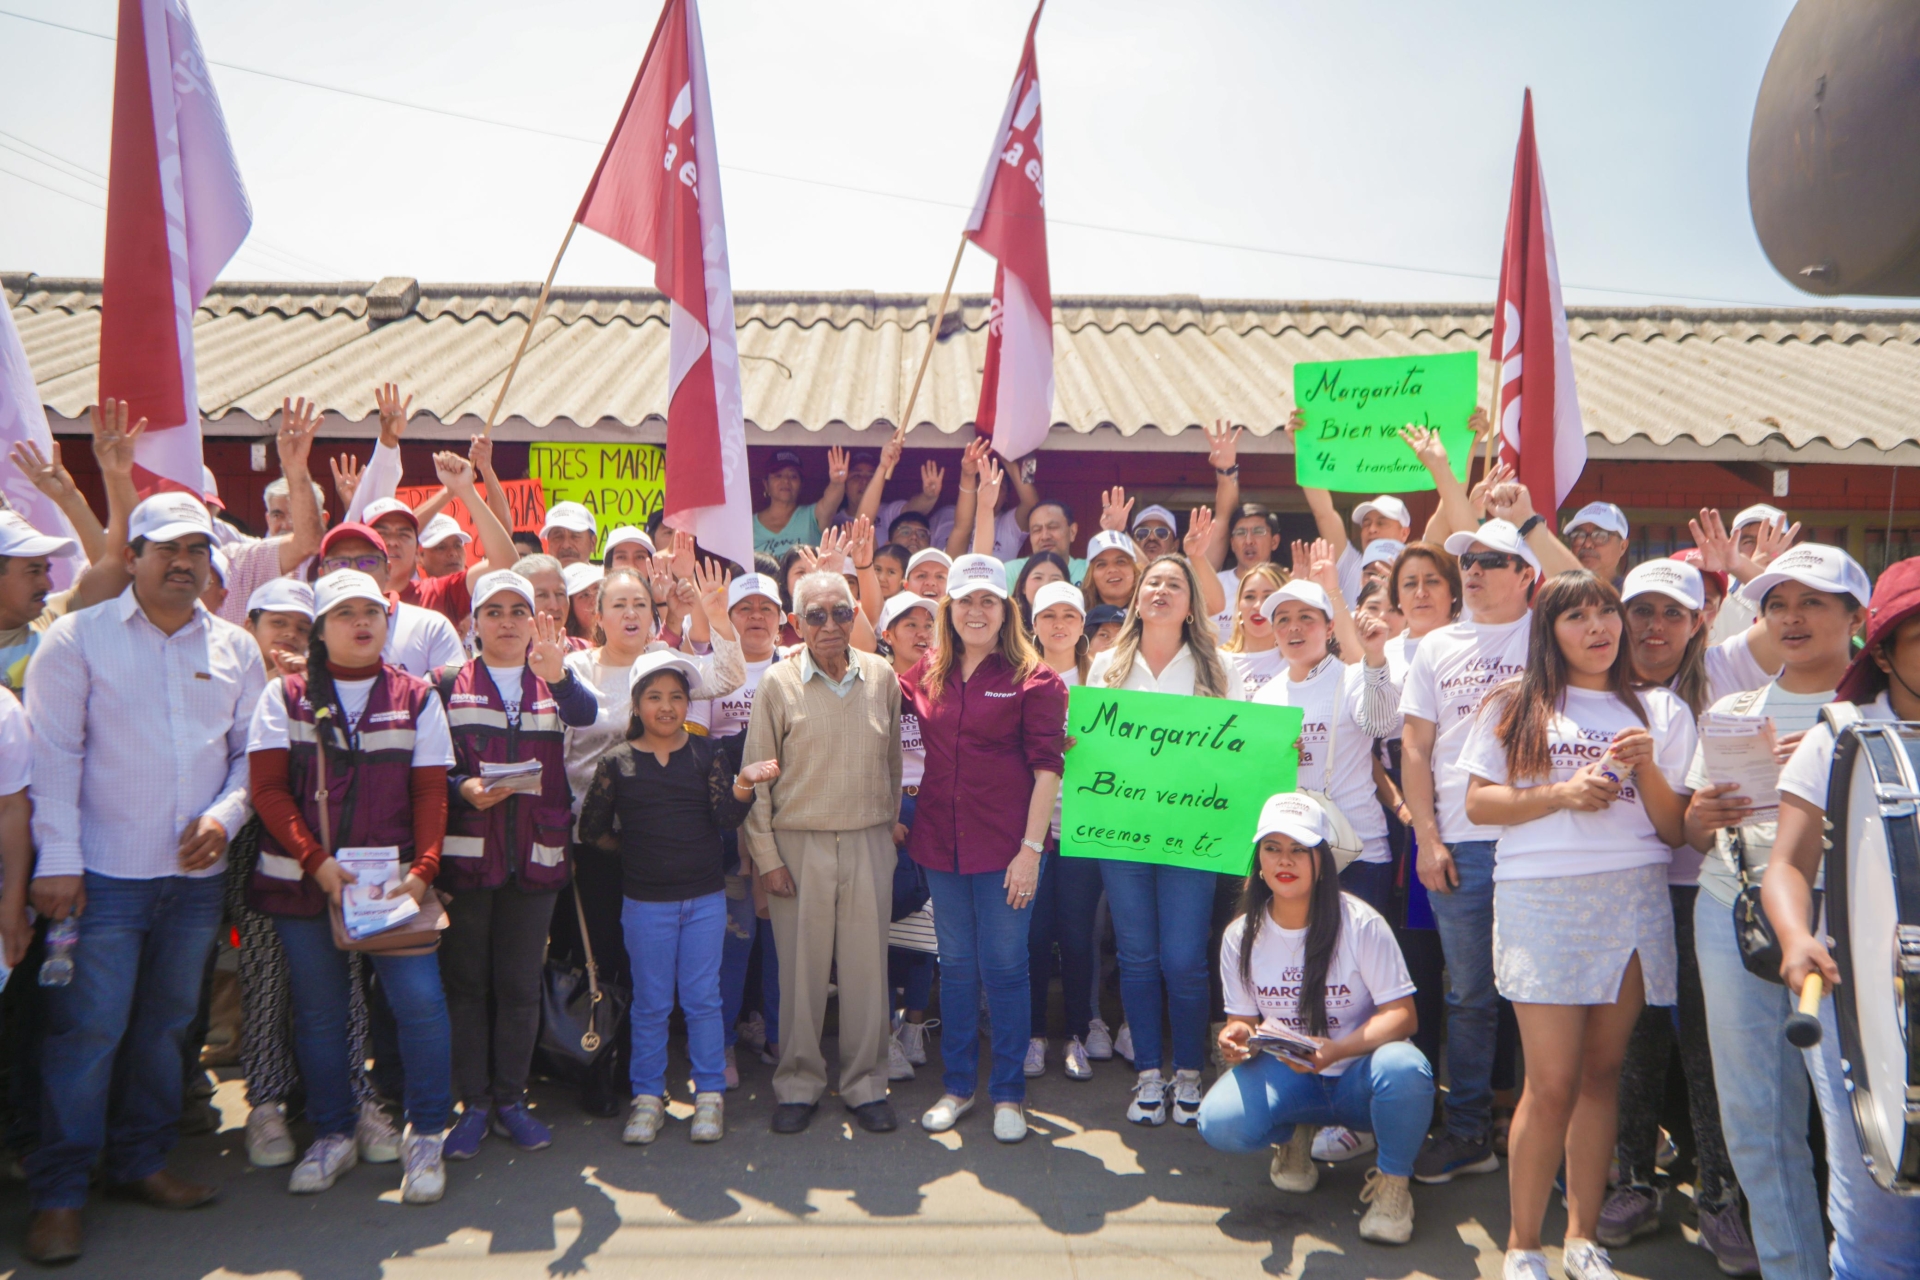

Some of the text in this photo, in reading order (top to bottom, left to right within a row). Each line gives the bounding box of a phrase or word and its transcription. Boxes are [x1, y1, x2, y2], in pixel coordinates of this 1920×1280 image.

[1305, 365, 1425, 410] Margarita
[1317, 418, 1372, 440] Bien
[531, 447, 667, 482] TRES MARIA
[450, 693, 489, 703] morena
[1081, 701, 1246, 757] Margarita
[1077, 771, 1230, 811] Bien venida
[1076, 823, 1151, 844] creemos
[1165, 837, 1184, 849] en
[1282, 972, 1304, 981] VO
